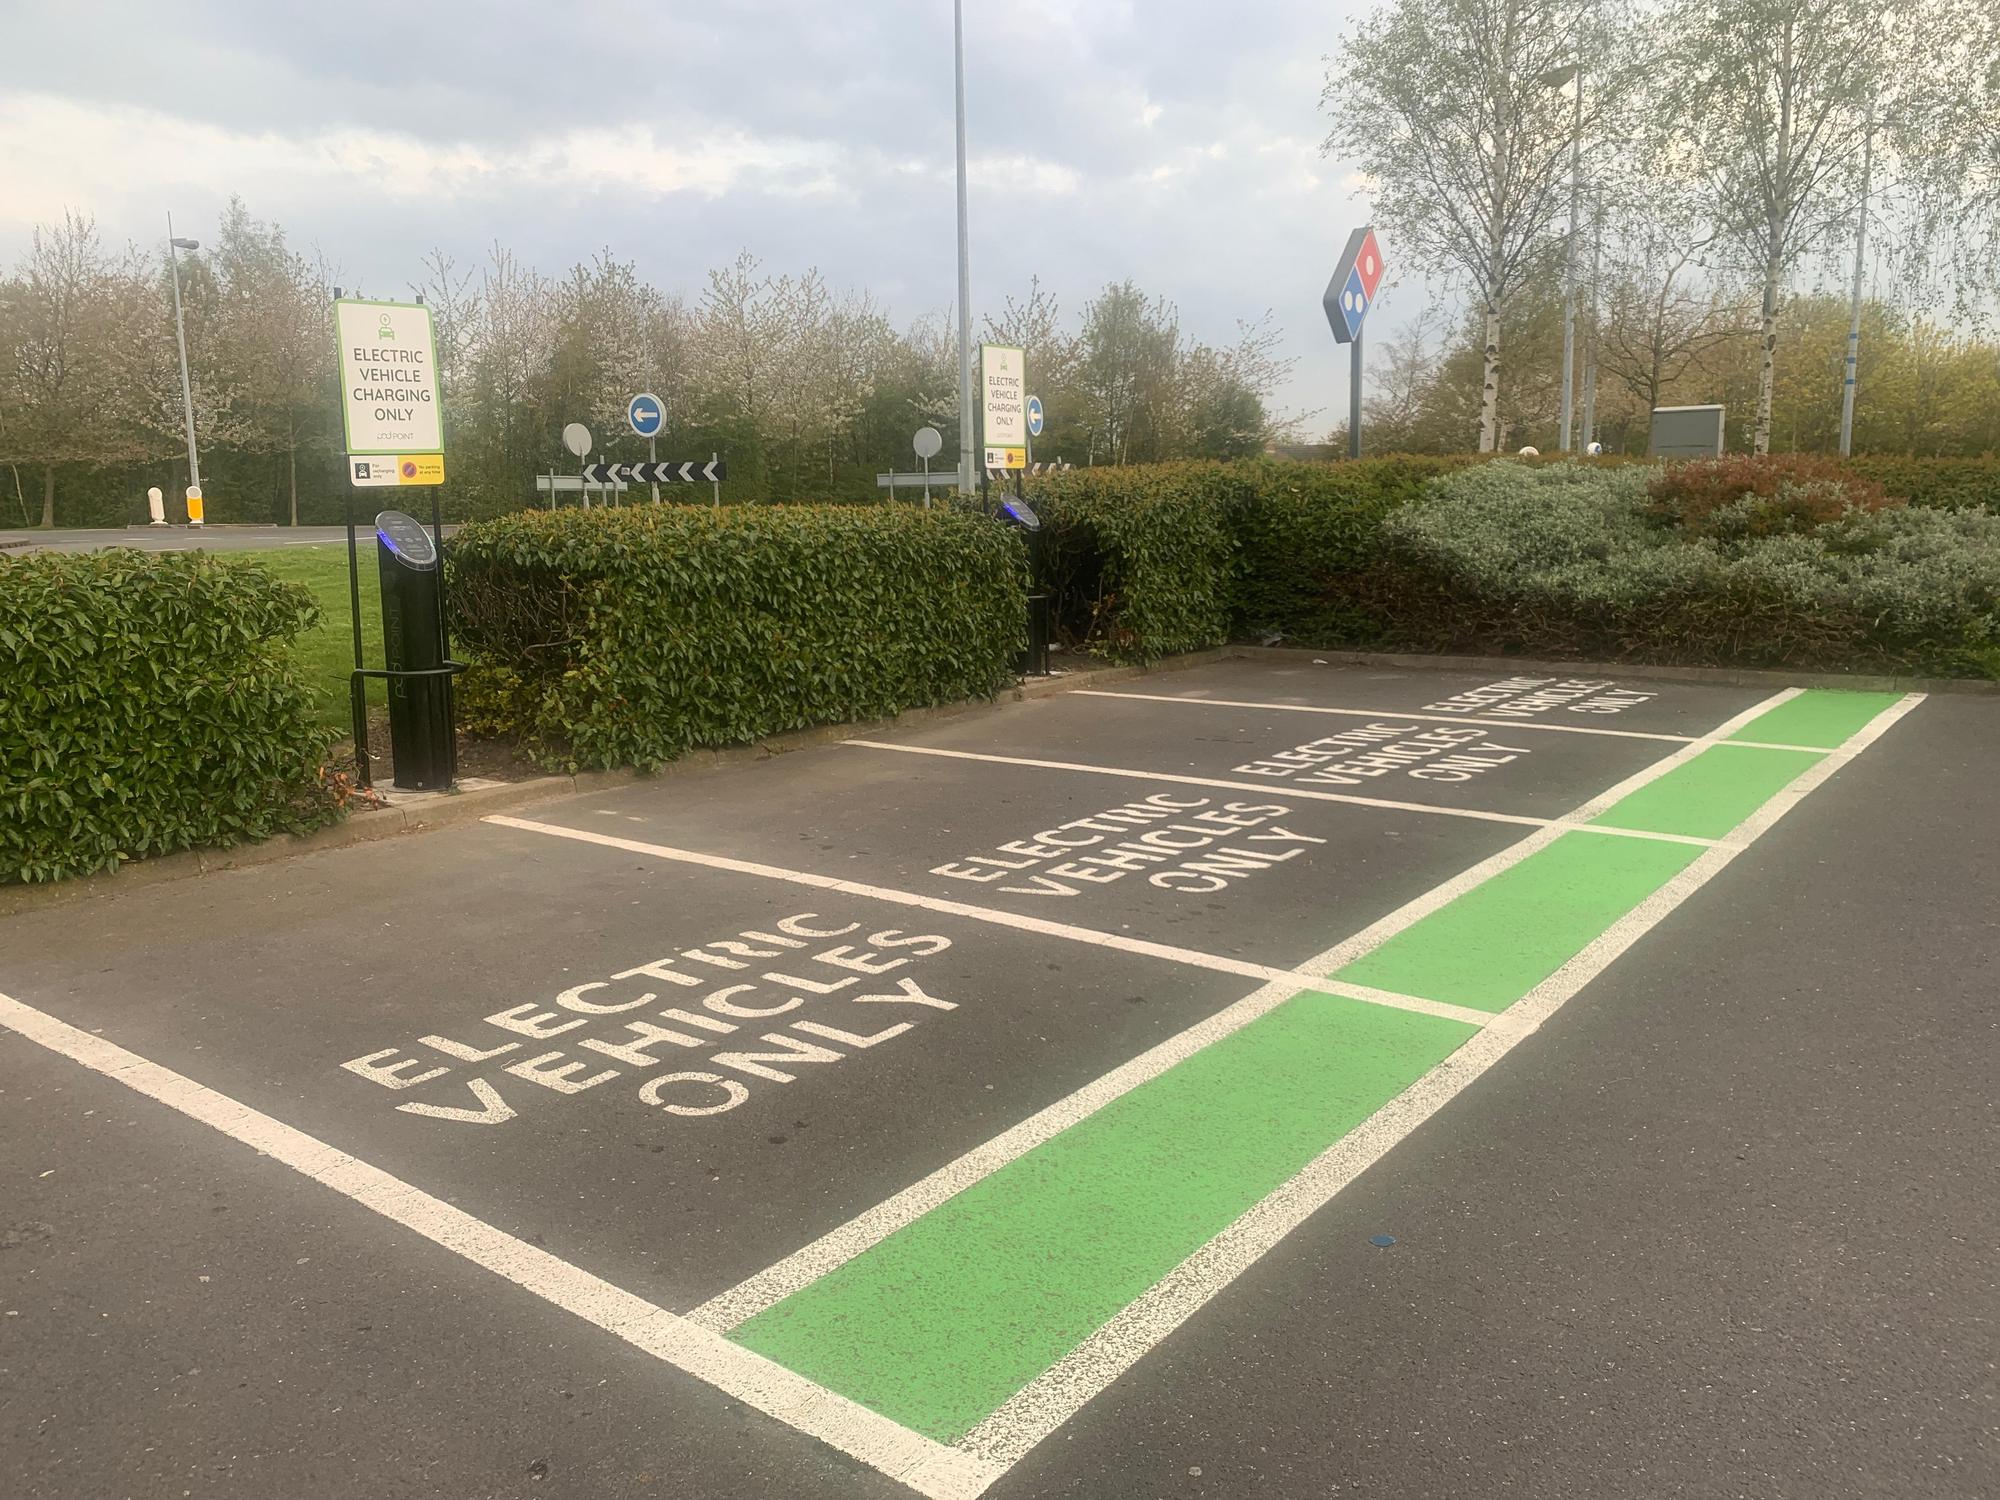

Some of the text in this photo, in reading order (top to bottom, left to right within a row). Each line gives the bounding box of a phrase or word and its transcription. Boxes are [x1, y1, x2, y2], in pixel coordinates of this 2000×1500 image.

[354, 348, 423, 363] ELECTRIC
[359, 368, 421, 382] VEHICLE
[354, 388, 431, 402] CHARGING
[988, 376, 1019, 387] ELECTRIC
[991, 390, 1018, 400] VEHICLE
[374, 408, 414, 421] ONLY
[987, 402, 1021, 413] CHARGING
[996, 416, 1014, 425] ONLY
[388, 608, 401, 659] POINT
[1567, 688, 1658, 714] ONLY
[1231, 723, 1419, 777] ELECTRIC
[1294, 727, 1489, 784] VEHICLES
[1407, 742, 1531, 782] ONLY
[928, 793, 1210, 882] ELECTRIC
[997, 802, 1290, 896] VEHICLES
[1148, 826, 1327, 893] ONLY
[339, 912, 861, 1089] ELECTRIC
[395, 930, 953, 1125] VEHICLES
[638, 977, 960, 1116] ONLY
